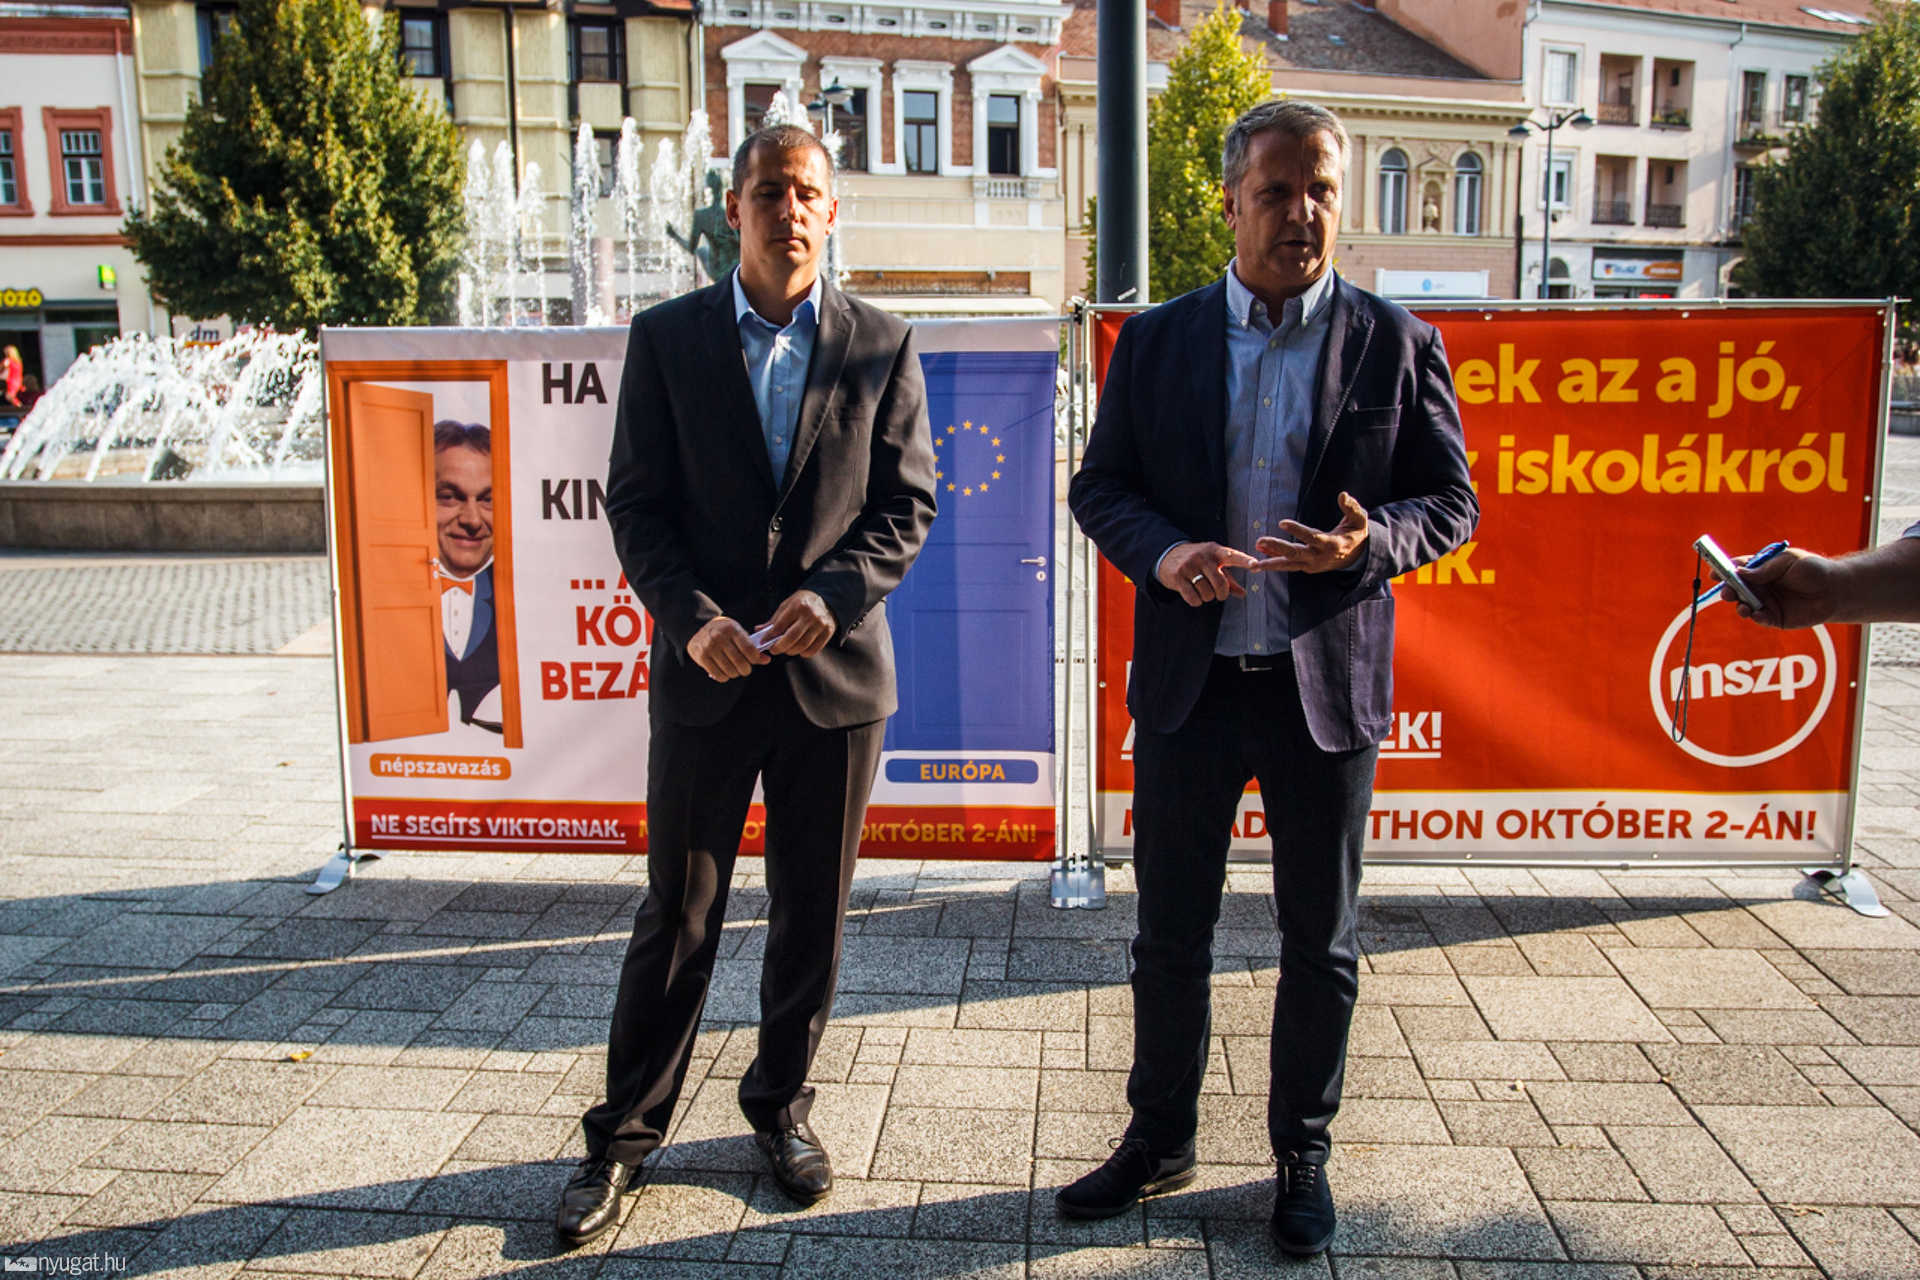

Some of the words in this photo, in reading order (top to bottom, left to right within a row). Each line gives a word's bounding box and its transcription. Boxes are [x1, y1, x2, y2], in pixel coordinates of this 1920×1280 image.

[191, 324, 219, 341] dm
[542, 362, 608, 405] HA
[1557, 358, 1639, 403] az
[1656, 357, 1697, 403] a
[1708, 340, 1802, 419] jó,
[1498, 432, 1848, 495] iskolákról
[1670, 654, 1818, 701] mszp
[379, 757, 501, 777] népszavazás
[920, 760, 1006, 781] EURÓPA
[371, 814, 400, 833] NE
[405, 812, 481, 835] SEGÍTS
[486, 817, 626, 838] VIKTORNAK.
[971, 819, 1037, 843] 2-ÁN!
[1495, 801, 1692, 840] OKTÓBER
[1703, 803, 1816, 841] 2-ÁN!
